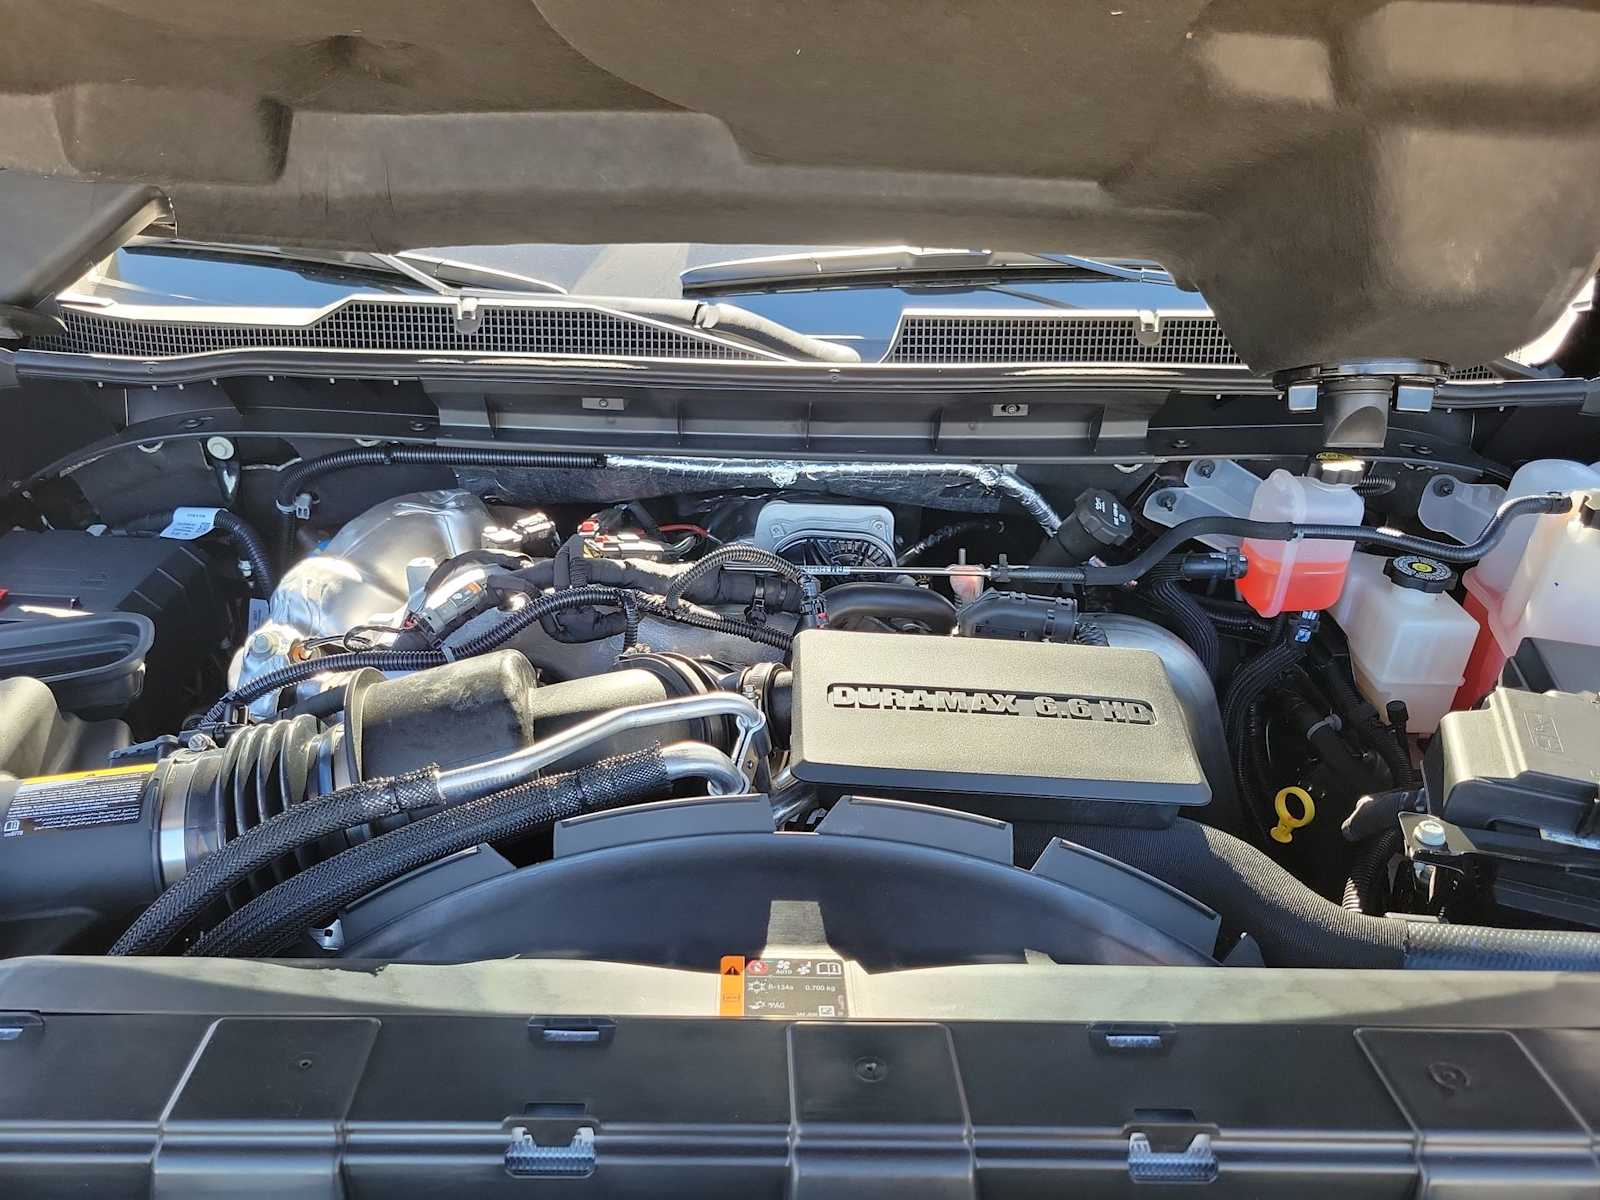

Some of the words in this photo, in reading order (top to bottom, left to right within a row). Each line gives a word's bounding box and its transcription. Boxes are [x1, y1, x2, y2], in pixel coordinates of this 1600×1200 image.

[832, 686, 1019, 715] DURAMAX
[1033, 695, 1093, 720] 6.6
[1099, 700, 1153, 725] HD
